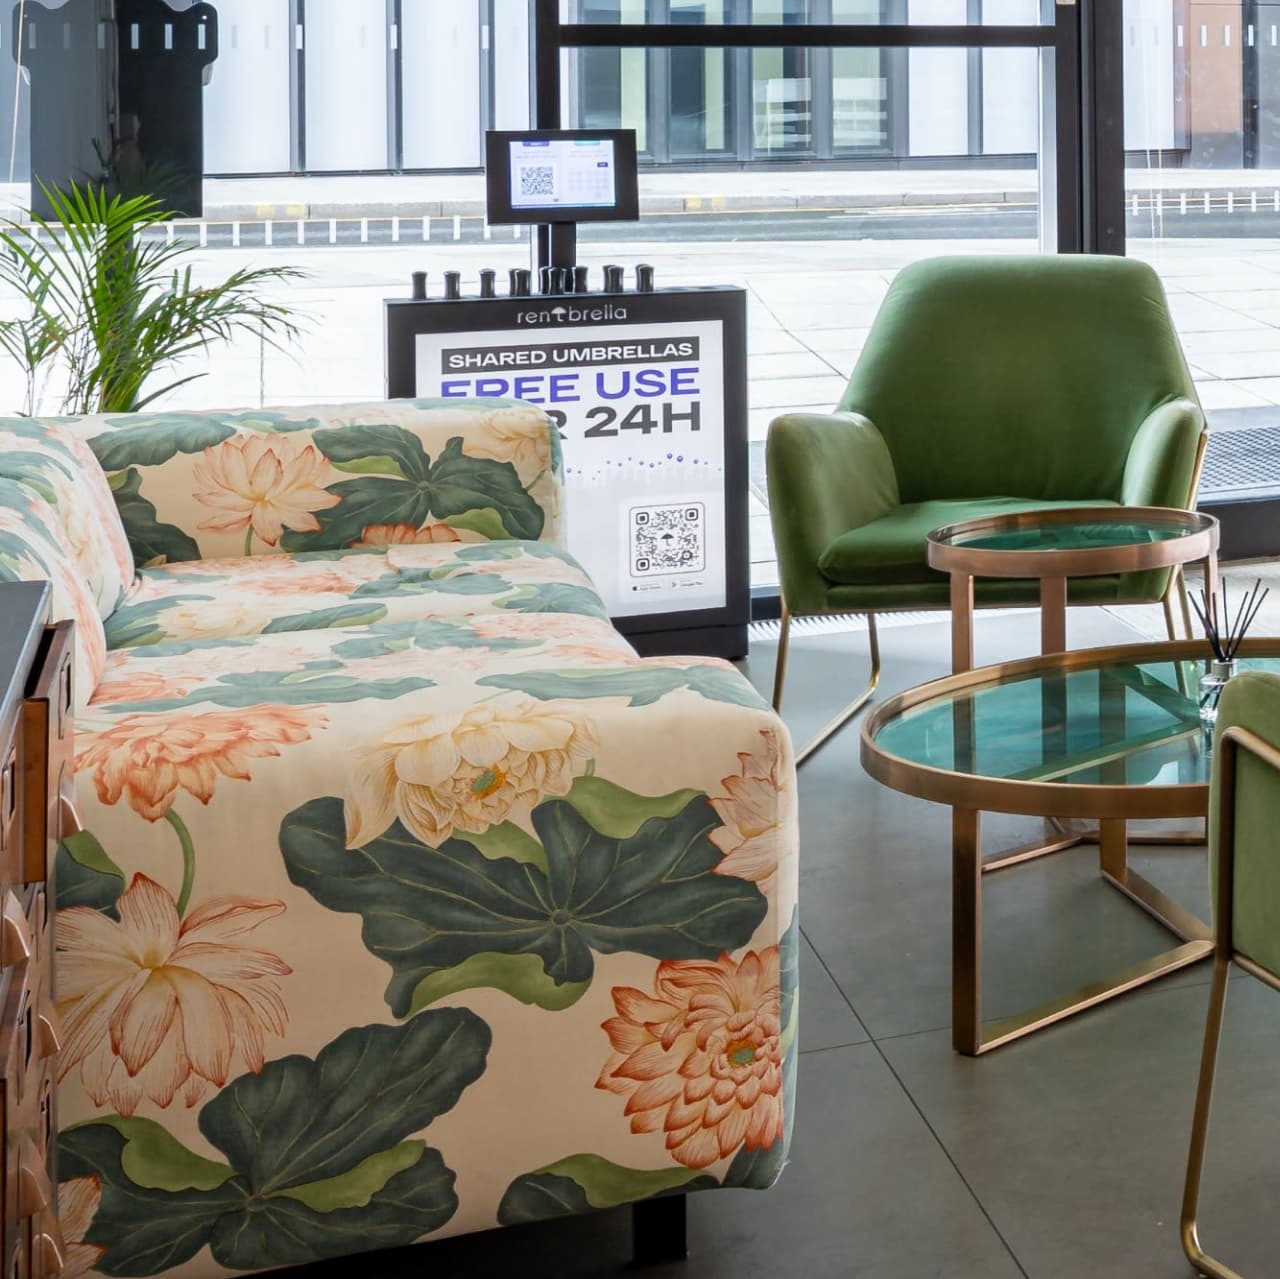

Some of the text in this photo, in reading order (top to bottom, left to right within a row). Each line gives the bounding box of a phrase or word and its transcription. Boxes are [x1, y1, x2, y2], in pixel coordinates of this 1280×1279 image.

[448, 342, 693, 369] SHARED UMBRELLAS
[595, 366, 700, 400] USE
[583, 400, 700, 439] 24H
